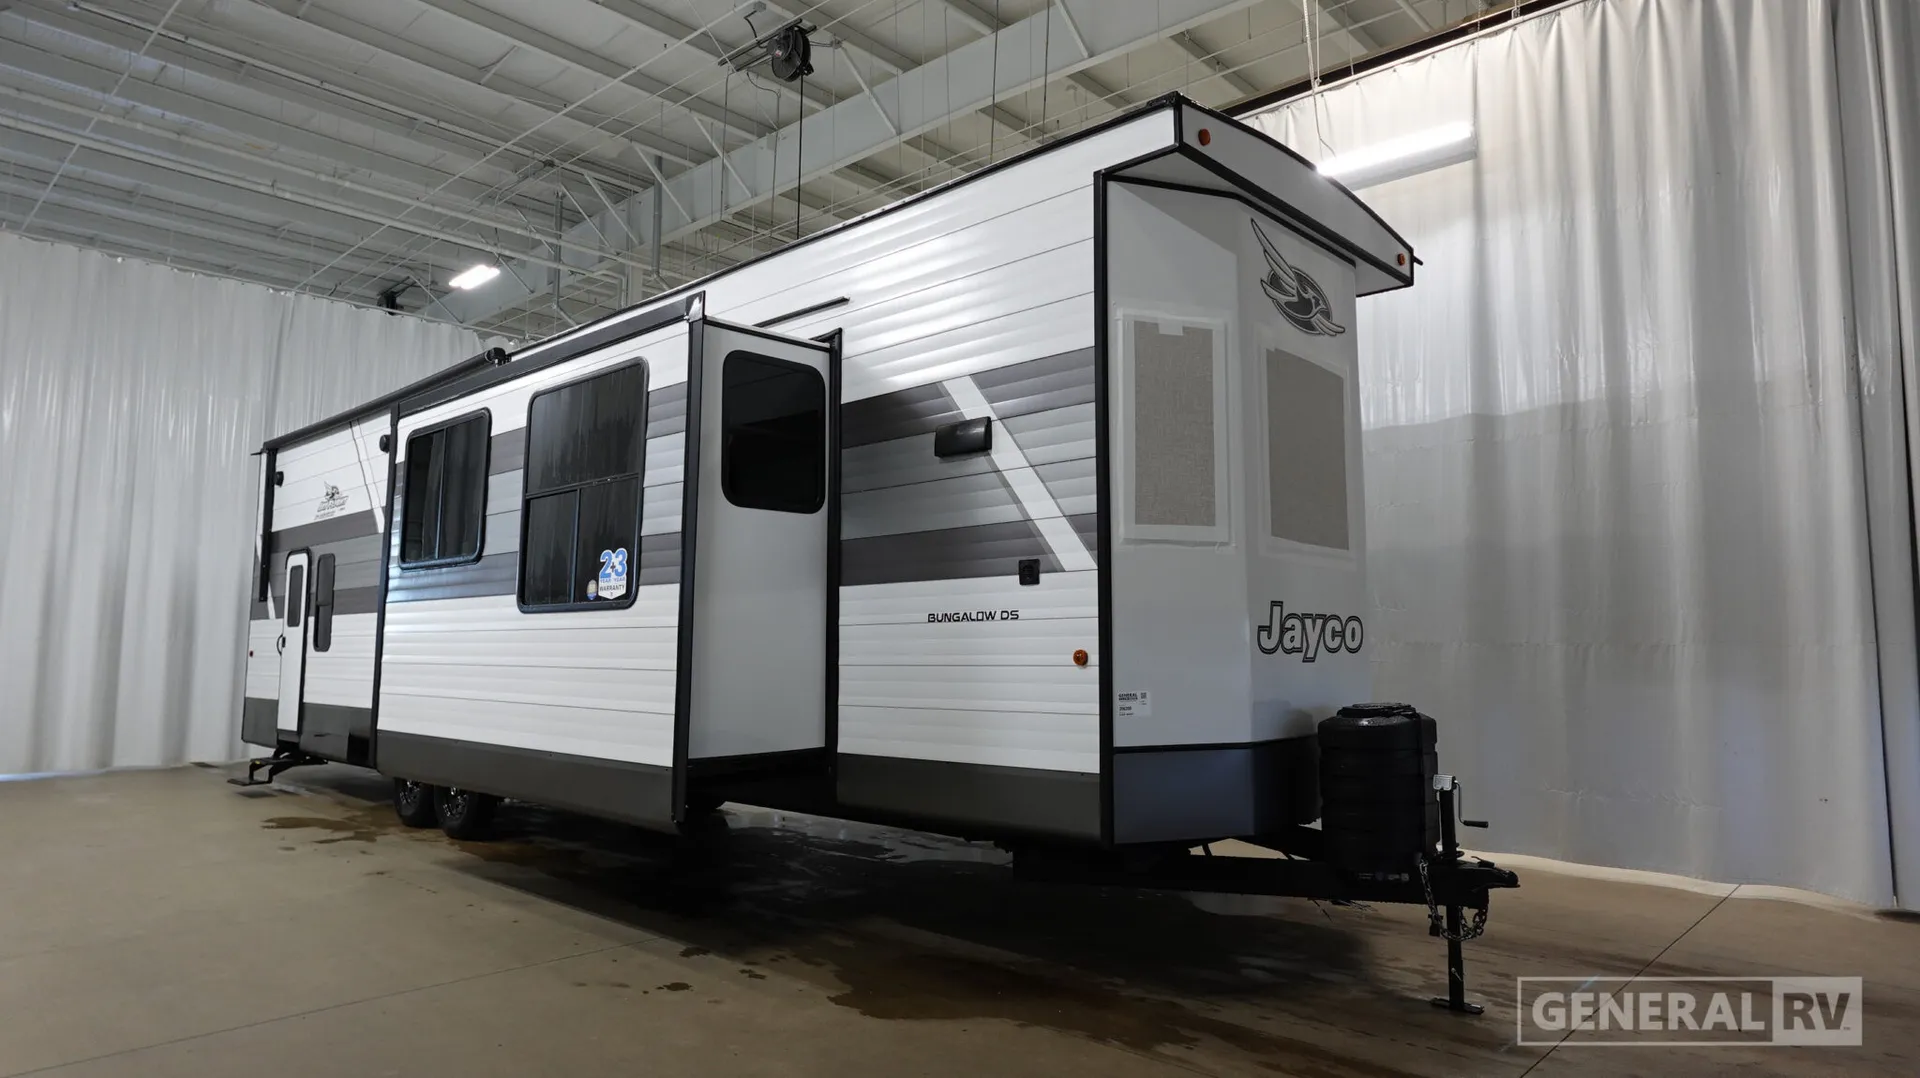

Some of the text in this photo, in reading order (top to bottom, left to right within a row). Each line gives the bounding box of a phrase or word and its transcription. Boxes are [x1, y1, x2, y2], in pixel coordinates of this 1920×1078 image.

[927, 610, 1020, 623] BUNGALOW DS
[1257, 600, 1364, 663] Jayco
